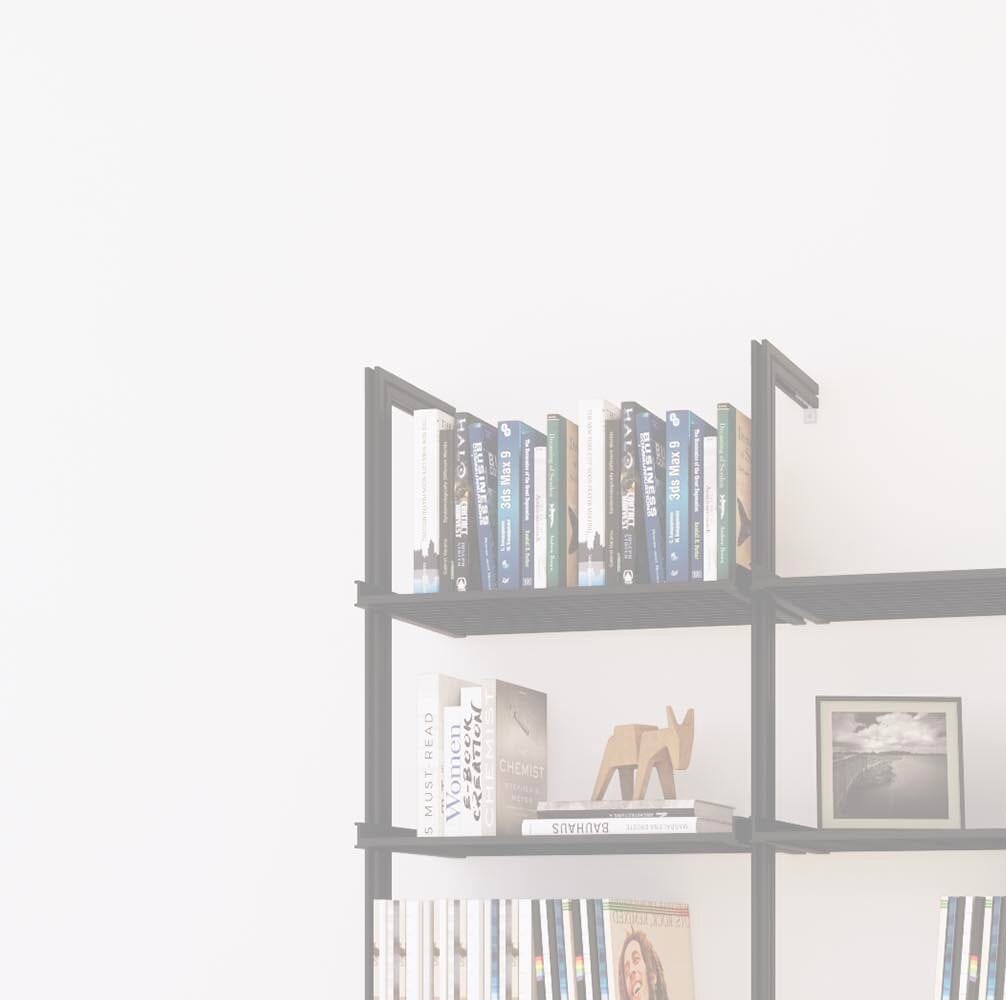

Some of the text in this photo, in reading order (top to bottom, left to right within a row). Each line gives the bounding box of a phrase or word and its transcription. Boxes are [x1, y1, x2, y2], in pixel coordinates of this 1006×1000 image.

[457, 418, 467, 479] HALO
[501, 450, 512, 458] 9
[624, 407, 634, 469] HALO
[669, 441, 680, 449] 9
[476, 442, 489, 526] BUSINESS
[501, 460, 512, 487] Max
[644, 432, 657, 517] BUSINESS
[669, 451, 680, 477] Max
[501, 484, 512, 509] 3ds
[669, 479, 680, 500] 3ds
[425, 712, 433, 760] READ
[446, 724, 462, 823] Women
[463, 711, 473, 809] E-BOOK
[471, 699, 482, 822] CREATION
[499, 759, 545, 779] CHEMIST
[425, 772, 433, 817] MUST
[551, 822, 609, 834] BAUHAUS
